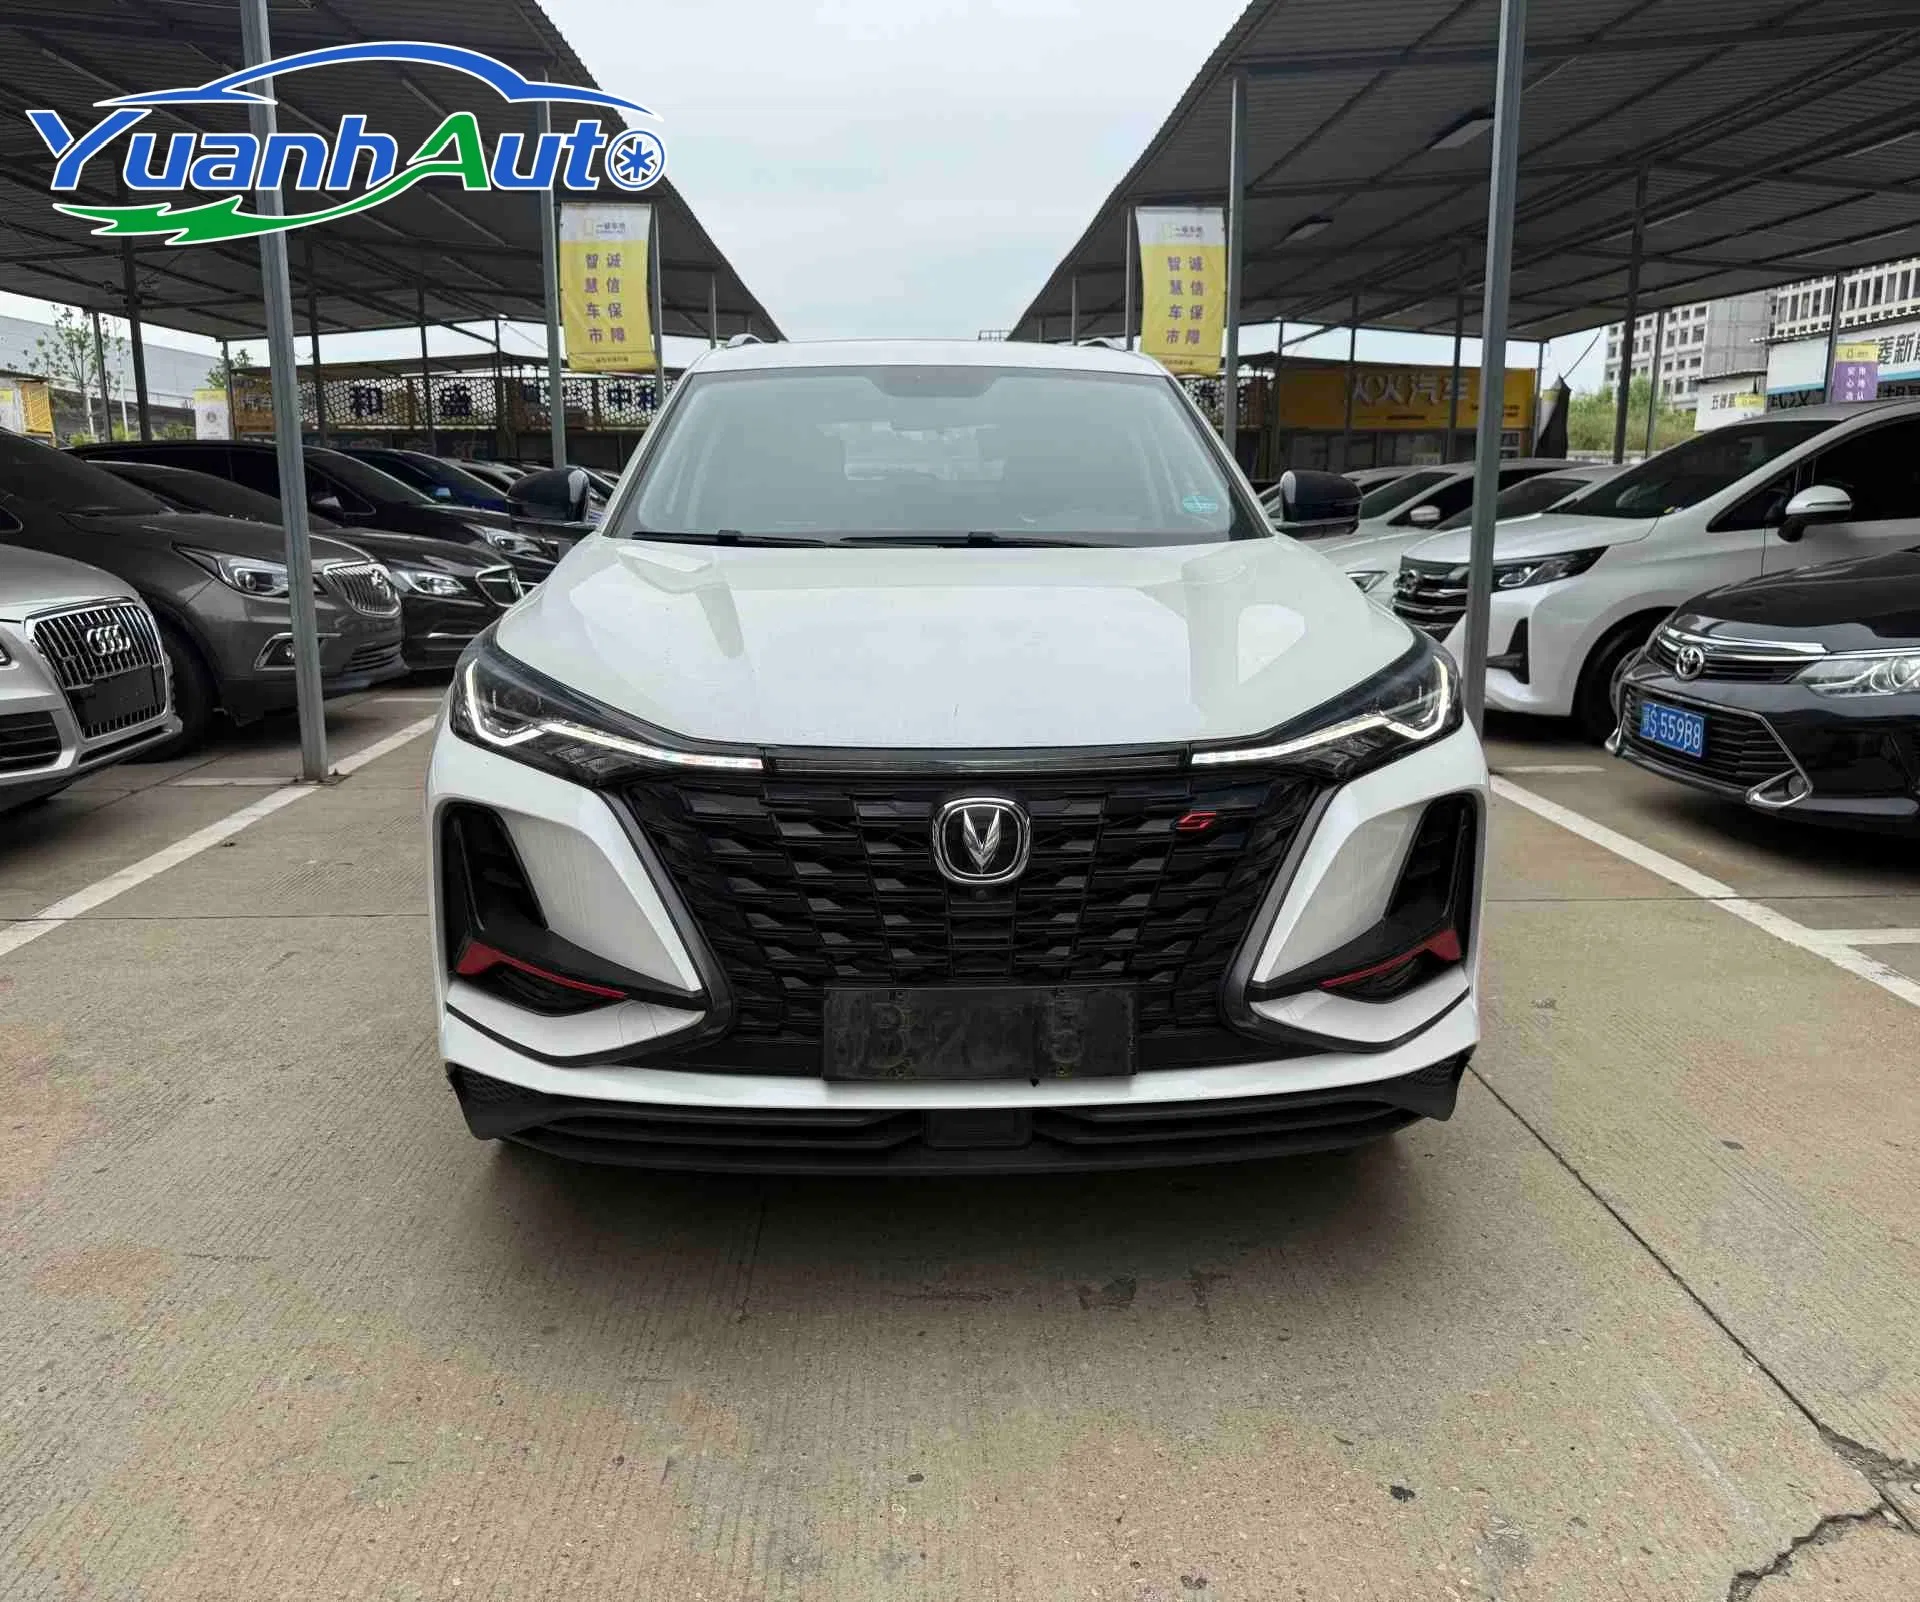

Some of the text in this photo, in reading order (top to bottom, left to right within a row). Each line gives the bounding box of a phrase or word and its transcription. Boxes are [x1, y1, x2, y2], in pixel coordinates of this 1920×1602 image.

[584, 252, 604, 344] 智慧车市
[606, 251, 626, 344] 诚信保障
[1166, 255, 1184, 345] 智慧车市
[1185, 255, 1205, 345] 诚信保障
